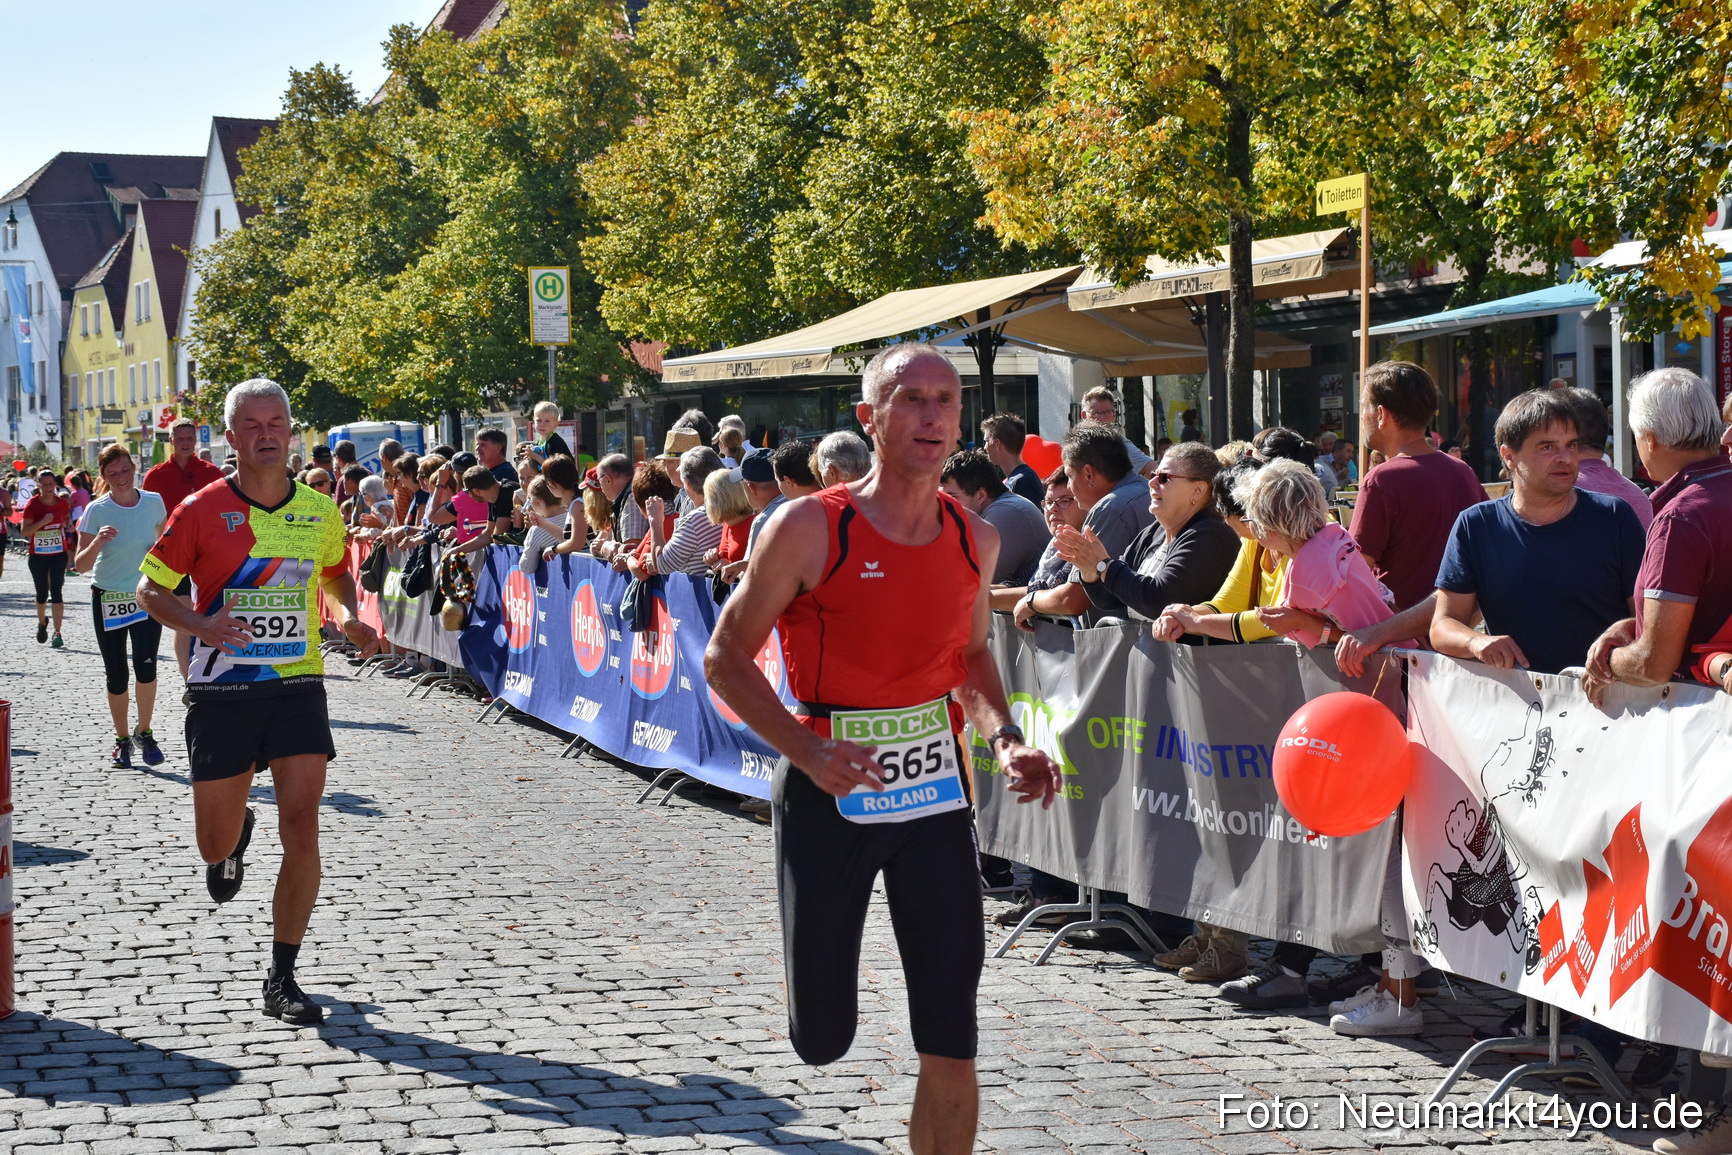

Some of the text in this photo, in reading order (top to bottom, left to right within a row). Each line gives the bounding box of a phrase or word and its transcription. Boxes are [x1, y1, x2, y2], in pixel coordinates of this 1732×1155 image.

[1326, 186, 1362, 204] Toiletten
[542, 278, 557, 296] H
[1722, 327, 1731, 401] ness Store
[202, 427, 208, 437] P
[37, 537, 60, 546] 2570
[861, 570, 885, 578] erima
[105, 592, 137, 601] BOC
[233, 592, 300, 609] BOCK
[107, 602, 137, 617] 280
[574, 600, 604, 656] Hervis
[241, 642, 301, 657] WERNER
[190, 684, 249, 692] www.bmw-partl.de
[844, 705, 941, 740] BOCK
[740, 750, 759, 777] GET
[876, 739, 943, 785] 665
[1306, 748, 1341, 763] energie
[862, 786, 939, 812] ROLAND
[0, 844, 11, 879] A
[1697, 956, 1728, 986] Sicher
